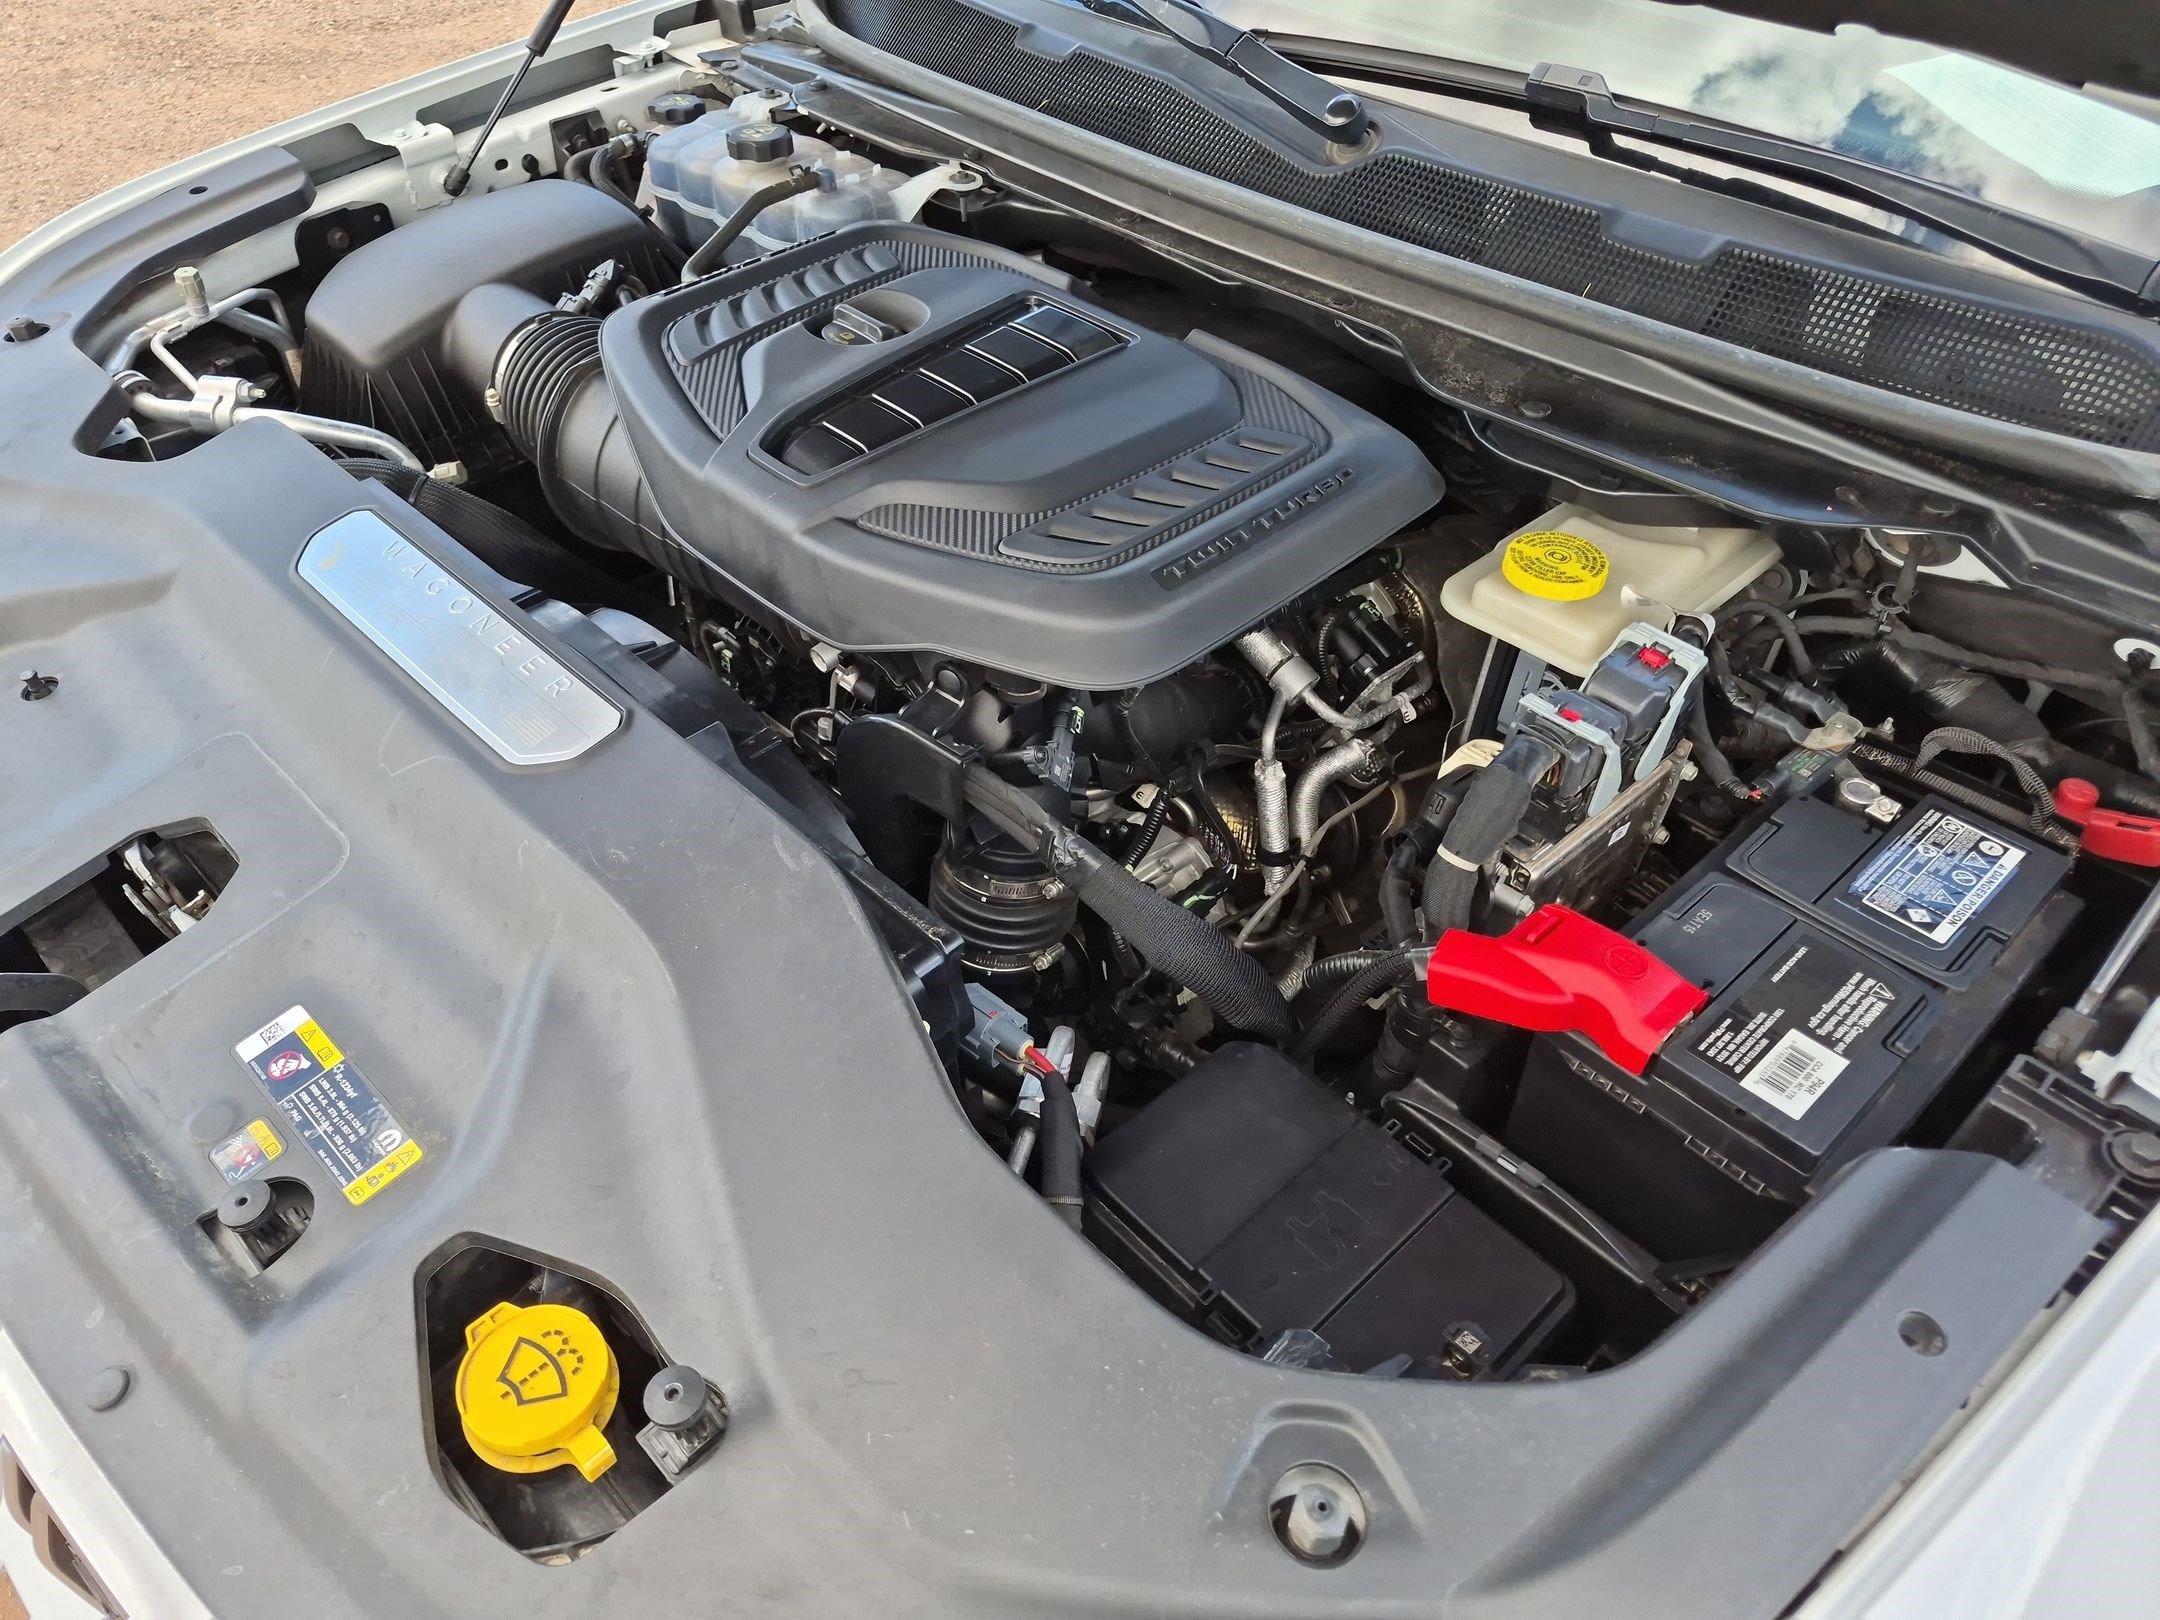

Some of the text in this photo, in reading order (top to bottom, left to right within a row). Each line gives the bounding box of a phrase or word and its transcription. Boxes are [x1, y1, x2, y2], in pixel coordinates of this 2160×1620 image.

[1163, 467, 1353, 578] TWIN TURBO
[1533, 557, 1557, 570] WARNING
[1535, 565, 1552, 573] FILLER
[382, 540, 574, 697] WAGONEER
[1771, 947, 1806, 982] LEAD ACID BATTERY
[1858, 978, 1876, 991] Wash
[1809, 972, 1862, 1027] www.P65Warnings.ca.gov
[1845, 989, 1864, 1005] hands
[1836, 1003, 1850, 1016] after
[1844, 995, 1876, 1025] Reproductive
[1752, 1012, 1766, 1024] SUITE
[1752, 1015, 1776, 1038] CORPORATE
[1832, 1024, 1850, 1038] Harm
[1833, 1001, 1886, 1053] WARNING: Cancer and
[1738, 1037, 1755, 1053] CENTER
[1747, 1038, 1768, 1058] IMPORTED
[1809, 1060, 1823, 1072] CCA
[335, 1073, 357, 1098] R-1234yf
[1793, 1081, 1804, 1090] RC
[1804, 1077, 1824, 1095] P94R
[290, 1109, 301, 1121] PAG
[357, 1126, 366, 1136] lb)
